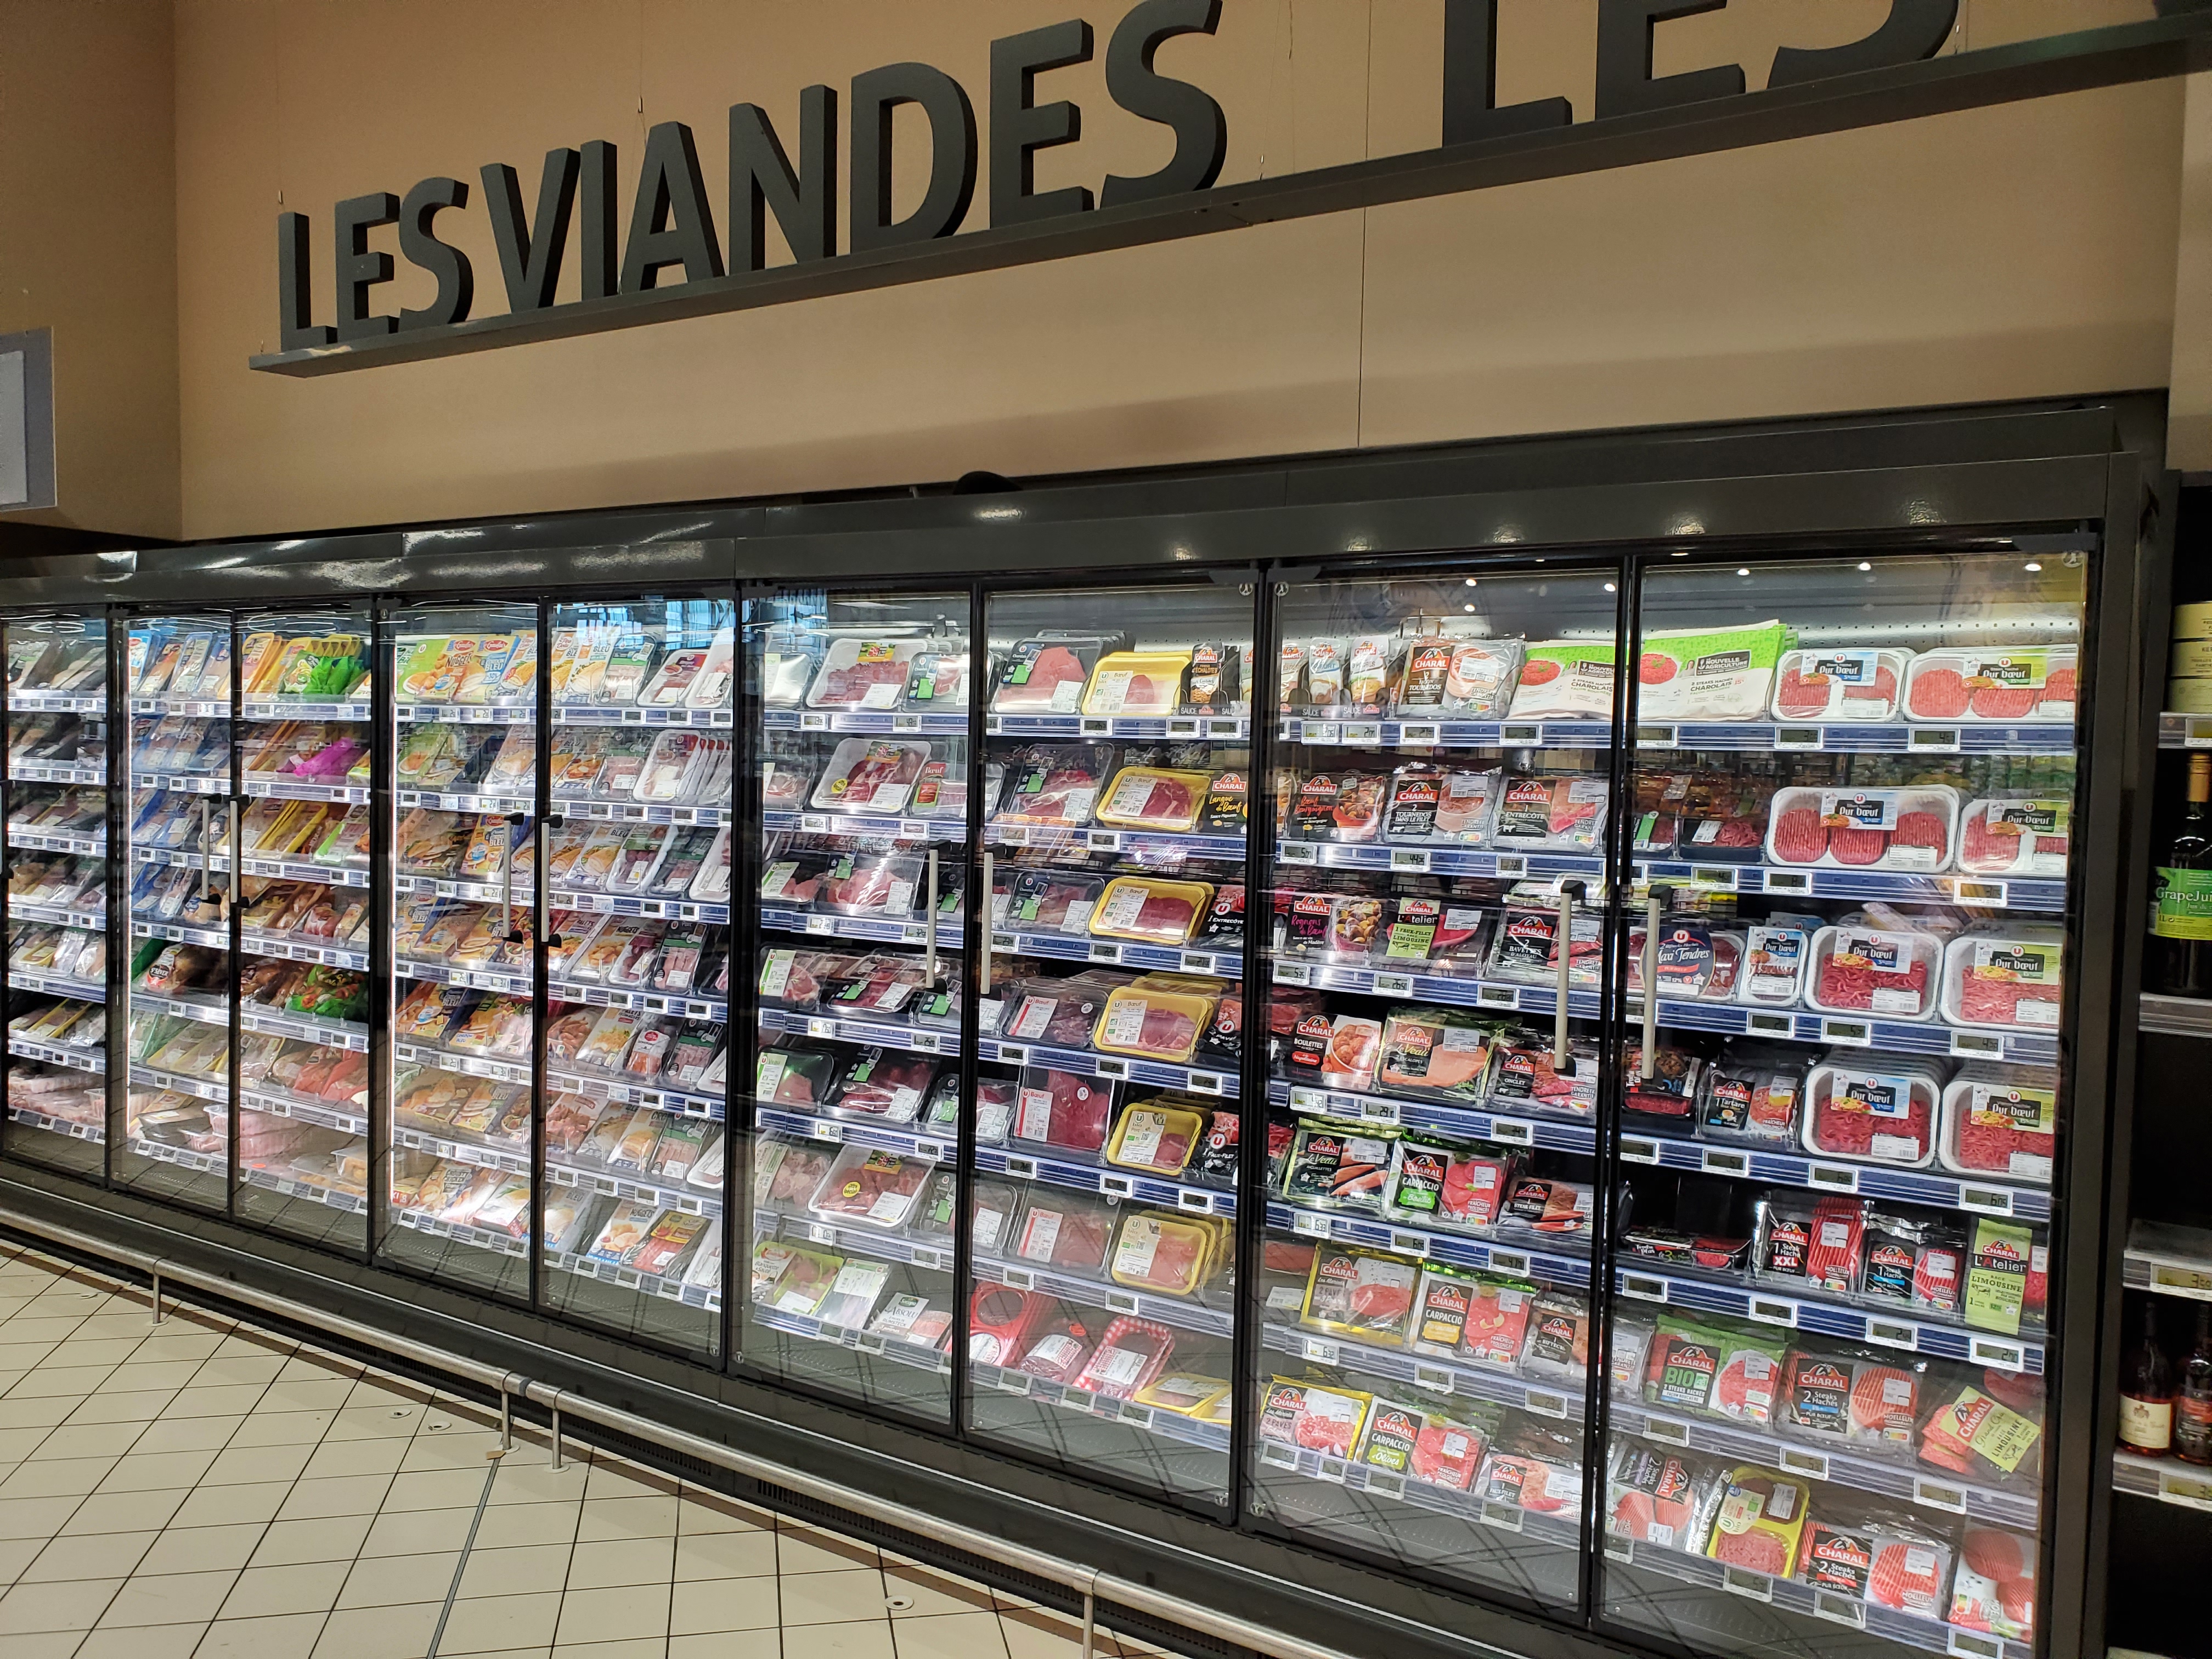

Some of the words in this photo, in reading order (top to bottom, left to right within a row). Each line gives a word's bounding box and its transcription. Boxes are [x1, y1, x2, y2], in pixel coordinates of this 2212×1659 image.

[279, 176, 473, 351] LES
[480, 0, 1228, 314] VIANDES
[1355, 647, 1377, 656] CHARAL
[485, 663, 502, 671] BLEU
[1415, 659, 1447, 672] CHARAL
[1705, 660, 1748, 669] AGRICULTURE
[1571, 681, 1613, 692] CHAROLAIS
[1690, 681, 1733, 692] CHAROLAIS
[1344, 707, 1361, 715] SAUCE
[1214, 782, 1245, 791] CHARAL
[1302, 784, 1335, 794] CHARAL
[1209, 794, 1234, 805] Langue
[1399, 792, 1435, 801] CHARAL
[1509, 792, 1548, 803] CHARAL
[1223, 802, 1242, 814] Bœuf
[1506, 811, 1545, 820] ENTRECÔTE
[611, 830, 629, 838] BLEU
[1295, 904, 1330, 913] CHARAL
[1398, 915, 1437, 924] L'Atelier
[1511, 926, 1549, 936] CHARAL
[1677, 932, 1685, 941] U
[1393, 935, 1429, 944] LIMOUSINE
[1676, 948, 1710, 962] Tendres
[1299, 1026, 1333, 1037] CHARAL
[1294, 1039, 1323, 1049] BOULETTES
[1399, 1034, 1430, 1045] CHARAL
[1505, 1062, 1532, 1072] CHARAL
[1716, 1087, 1750, 1099] CHARAL
[1721, 1098, 1745, 1108] Tartare
[1310, 1145, 1339, 1155] CHARAL
[1406, 1163, 1441, 1178] CHARAL
[1402, 1177, 1439, 1192] CARPACCIO
[1518, 1190, 1545, 1199] CHARAL
[1773, 1231, 1807, 1243] CHARAL
[1983, 1245, 2018, 1259] CHARAL
[1774, 1256, 1798, 1267] XXL
[1872, 1253, 1910, 1266] CHARAL
[1975, 1255, 2027, 1271] L'Atelier
[1323, 1266, 1357, 1278] CHARAL
[1971, 1276, 2022, 1293] LIMOUSINE
[1430, 1295, 1465, 1312] CHARAL
[1426, 1309, 1463, 1324] CARPACCIO
[1542, 1324, 1572, 1338] CHARAL
[1491, 1335, 1514, 1344] FRAÎCHEUR
[1491, 1340, 1513, 1350] PROLONGÉE
[1671, 1355, 1711, 1370] CHARAL
[1665, 1367, 1694, 1387] BIO
[1801, 1375, 1844, 1388] CHARAL
[1669, 1385, 1685, 1394] STEAKS
[1803, 1391, 1812, 1403] 2
[1814, 1391, 1837, 1401] Steaks
[1272, 1397, 1305, 1411] CHARAL
[1812, 1398, 1838, 1408] Hachés
[1884, 1414, 1914, 1425] MOELLEUX
[1960, 1401, 1991, 1438] CHARAL
[1378, 1419, 1413, 1440] CHARAL
[1372, 1434, 1410, 1452] CARPACCIO
[1991, 1419, 2022, 1457] LIMOUSINE
[1437, 1468, 1460, 1477] FRAÎCHEUR
[1437, 1472, 1460, 1482] PROLONGÉE
[1493, 1471, 1521, 1485] CHARAL
[1660, 1460, 1678, 1494] CHARAL
[1818, 1546, 1864, 1564] CHARAL
[1819, 1561, 1827, 1573] 2
[1831, 1562, 1855, 1575] Steaks
[1828, 1567, 1855, 1580] Hachés
[1903, 1592, 1934, 1603] MOELLEUX
